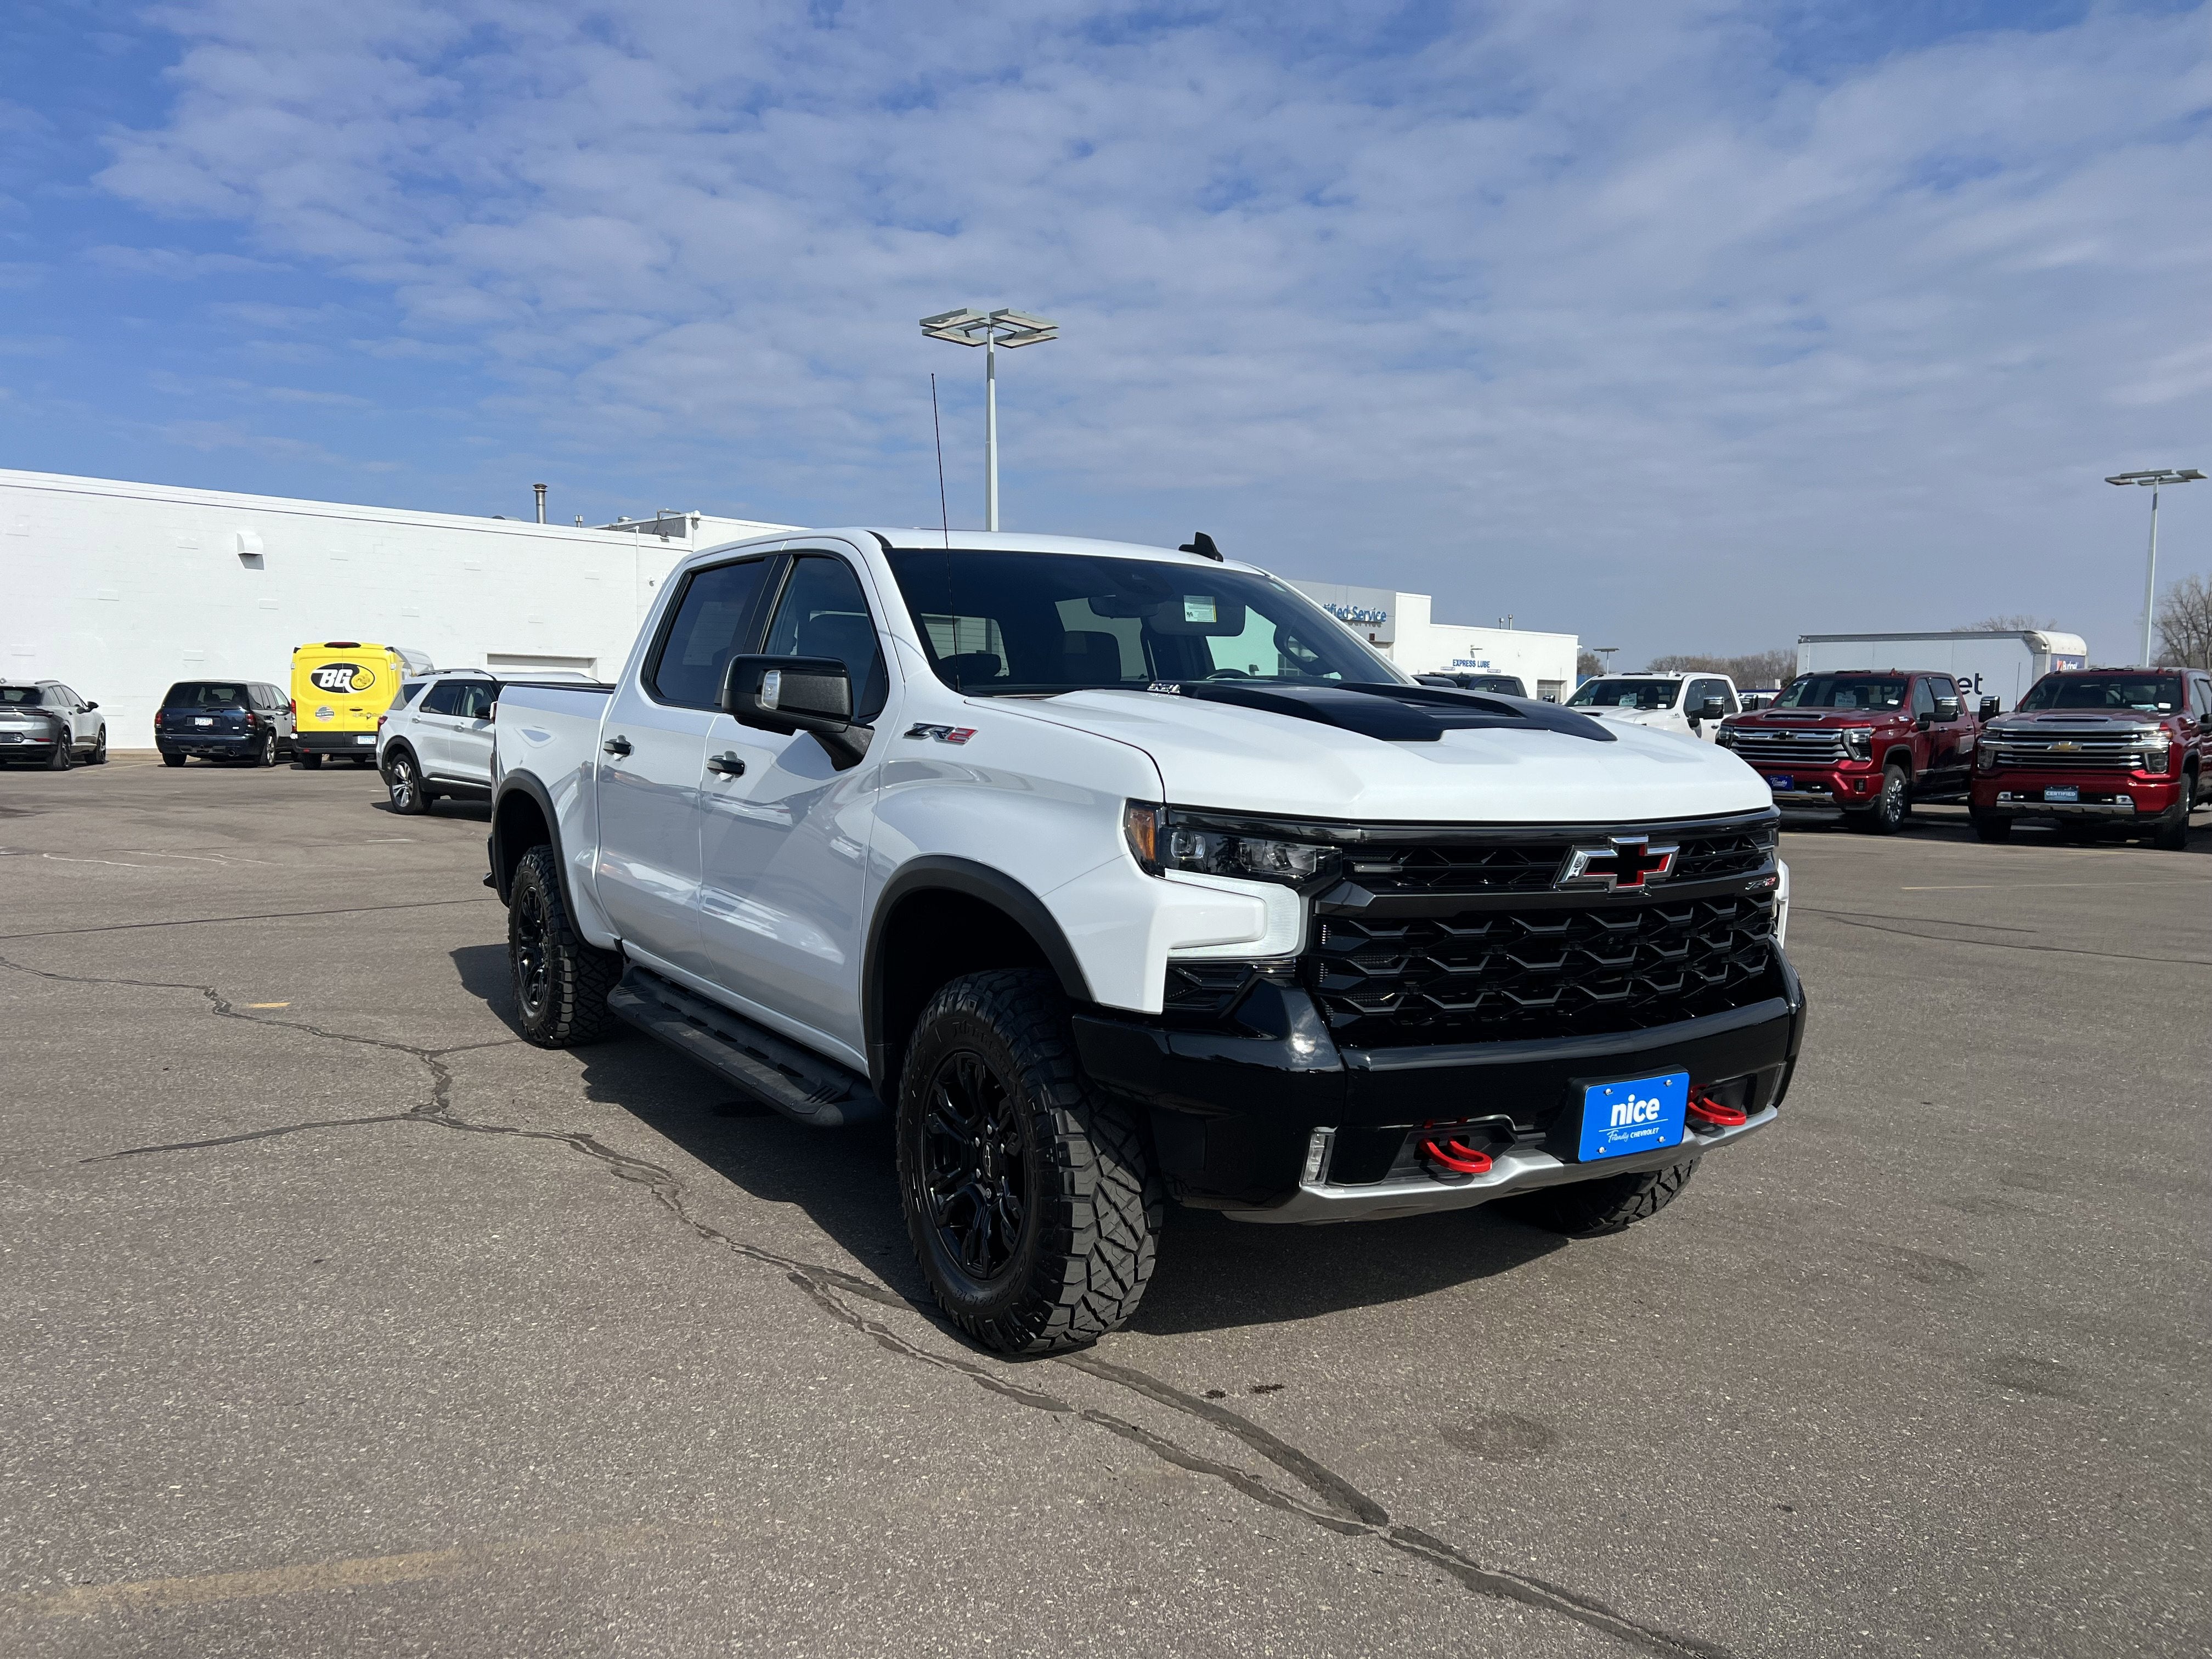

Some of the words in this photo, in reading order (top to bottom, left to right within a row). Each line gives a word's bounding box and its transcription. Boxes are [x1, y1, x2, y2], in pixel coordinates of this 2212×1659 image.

[1352, 606, 1387, 622] Service
[1452, 659, 1476, 667] EXPRESS
[312, 669, 354, 690] BG
[902, 723, 978, 745] ZR2
[1610, 1094, 1660, 1127] nice
[1630, 1127, 1660, 1138] CHEVROLET
